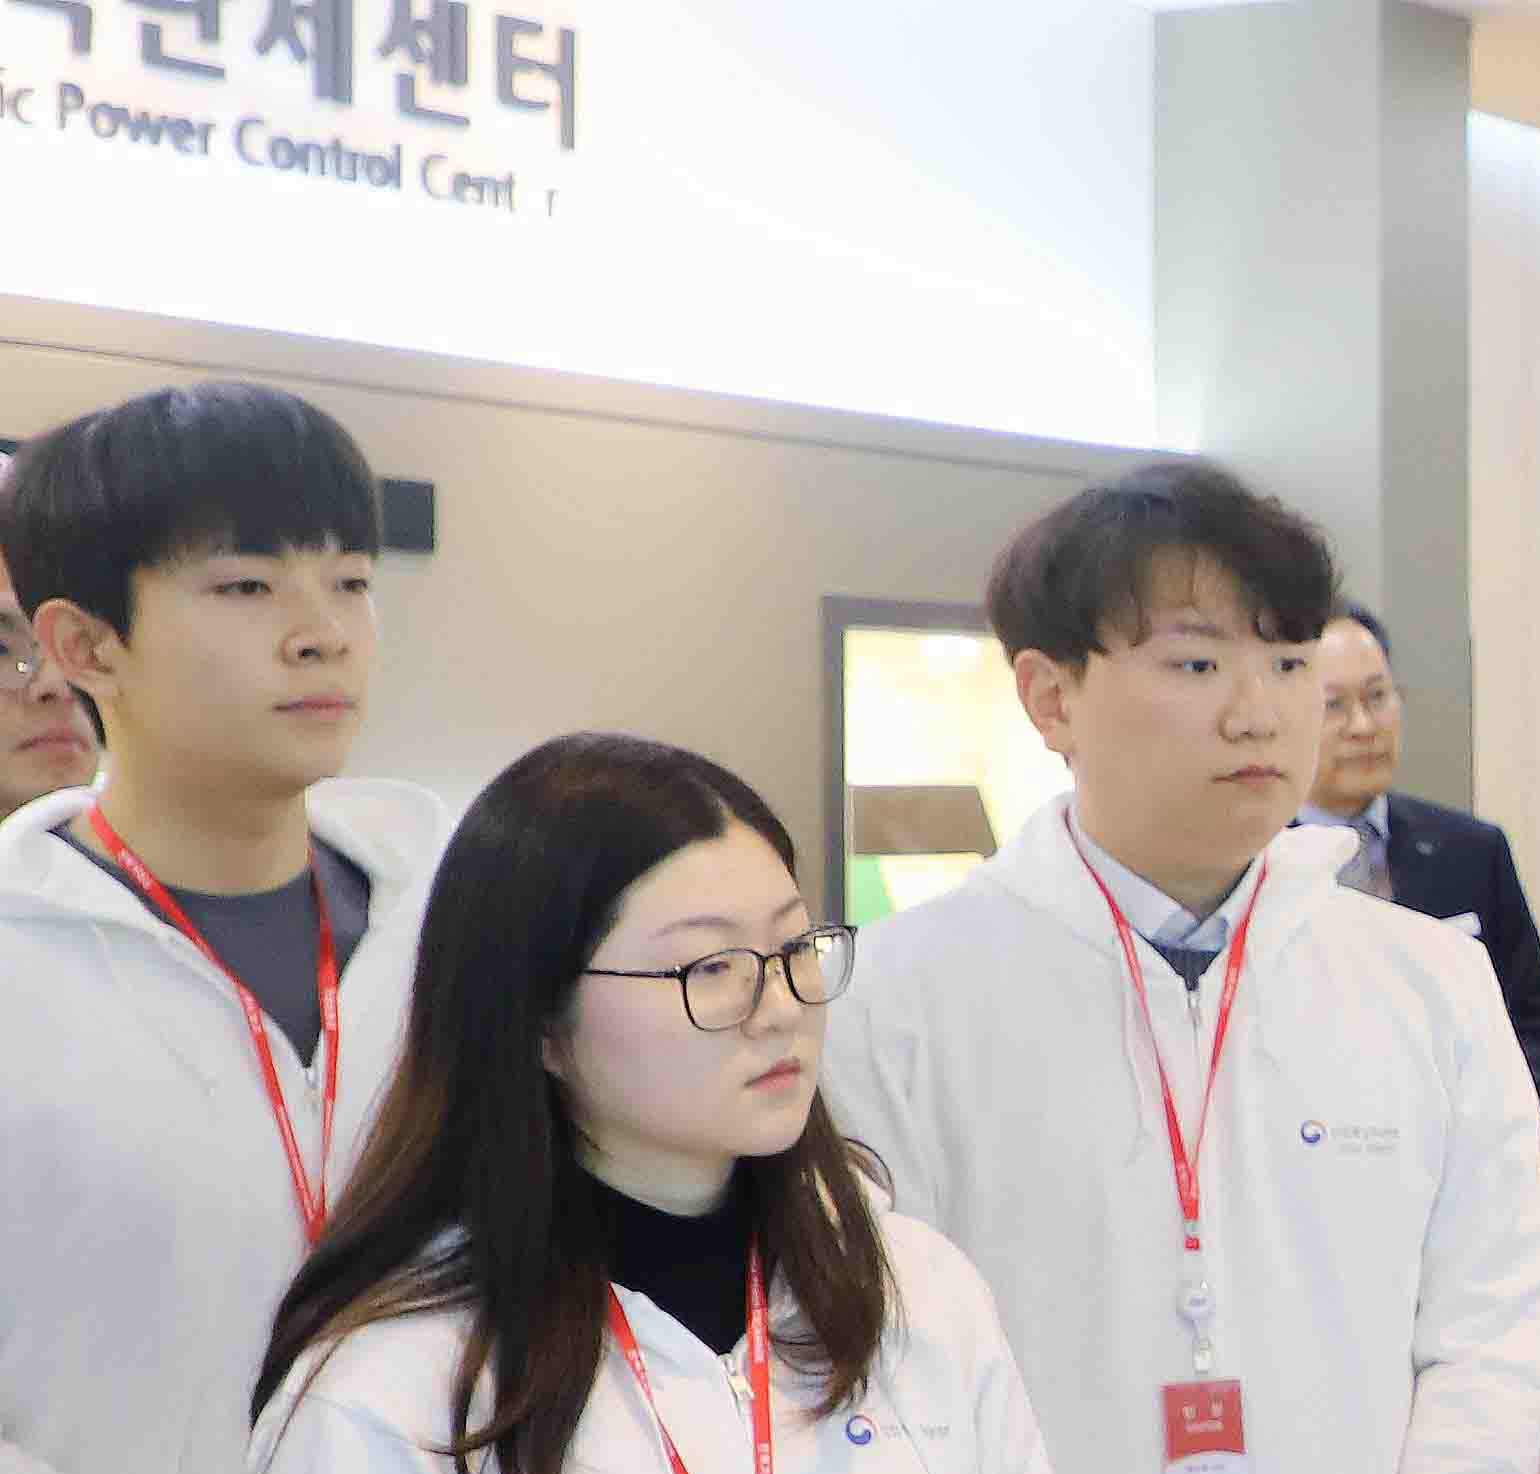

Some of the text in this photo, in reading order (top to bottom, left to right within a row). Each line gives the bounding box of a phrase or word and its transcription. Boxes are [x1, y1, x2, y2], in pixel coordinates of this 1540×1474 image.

[56, 82, 218, 158] Power
[232, 116, 403, 191] Control
[419, 154, 559, 218] Centr
